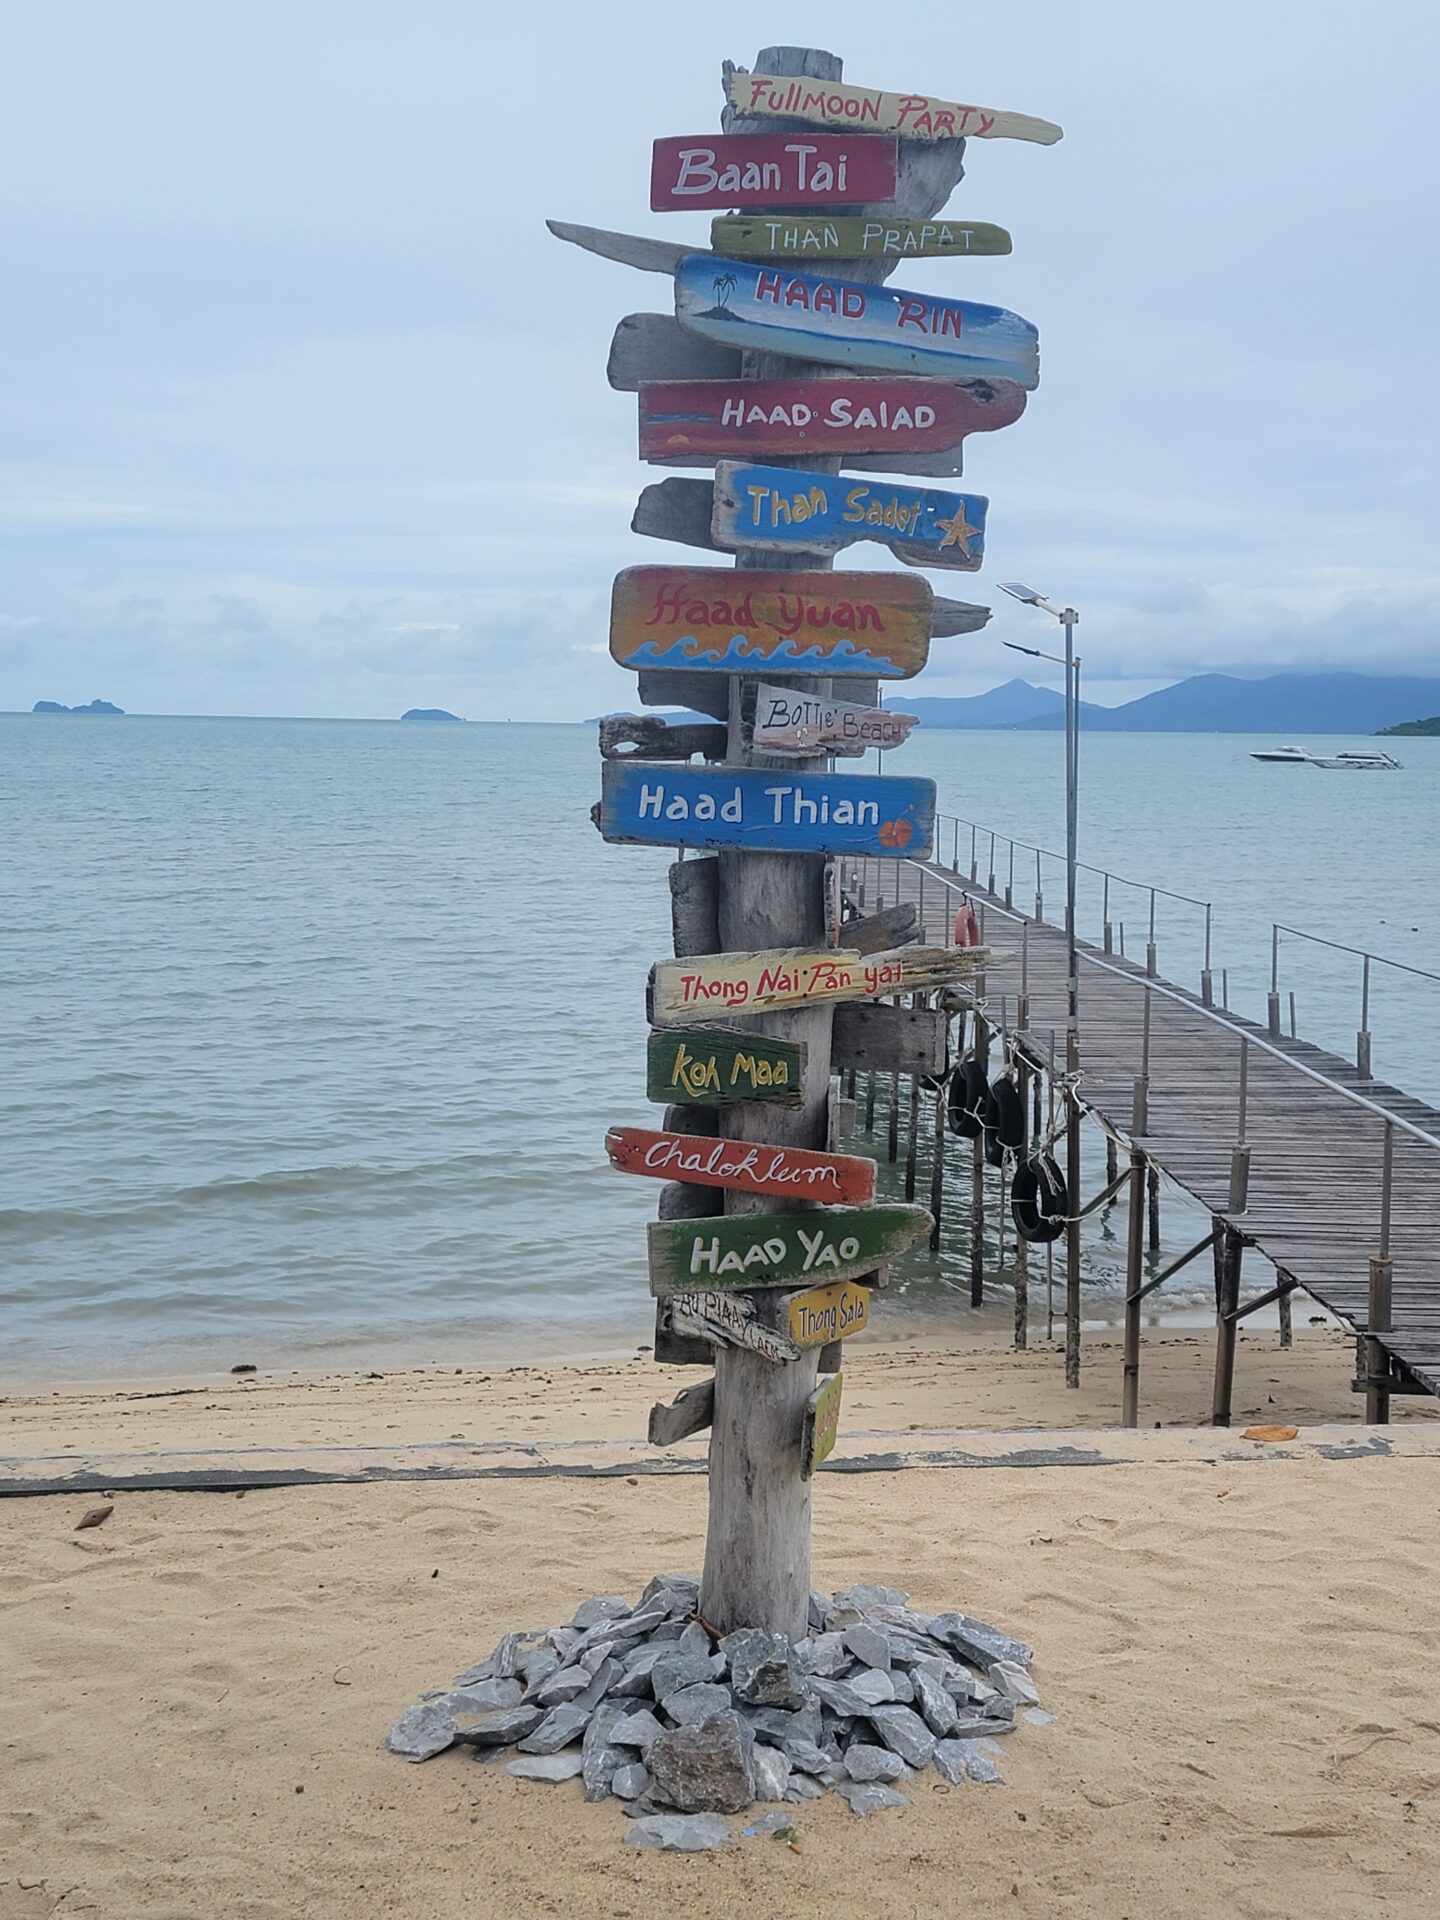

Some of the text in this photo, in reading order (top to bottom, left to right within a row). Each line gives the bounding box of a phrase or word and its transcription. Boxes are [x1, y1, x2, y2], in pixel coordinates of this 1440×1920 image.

[897, 96, 995, 136] PARTY
[671, 144, 849, 195] Baan Tai
[765, 223, 976, 252] THAN PRAPAT
[755, 270, 964, 340] HAAD RIN
[721, 398, 811, 428] HAAD
[747, 485, 922, 537] Than Sadet
[645, 582, 759, 630] Haad
[638, 784, 880, 826] Haad Thian
[680, 975, 749, 1008] Thong
[756, 964, 800, 996] Nai
[807, 962, 852, 993] Pan
[730, 1052, 789, 1089] Maa
[690, 1229, 860, 1275] HAAD YAO
[798, 1292, 865, 1339] Thong Sala
